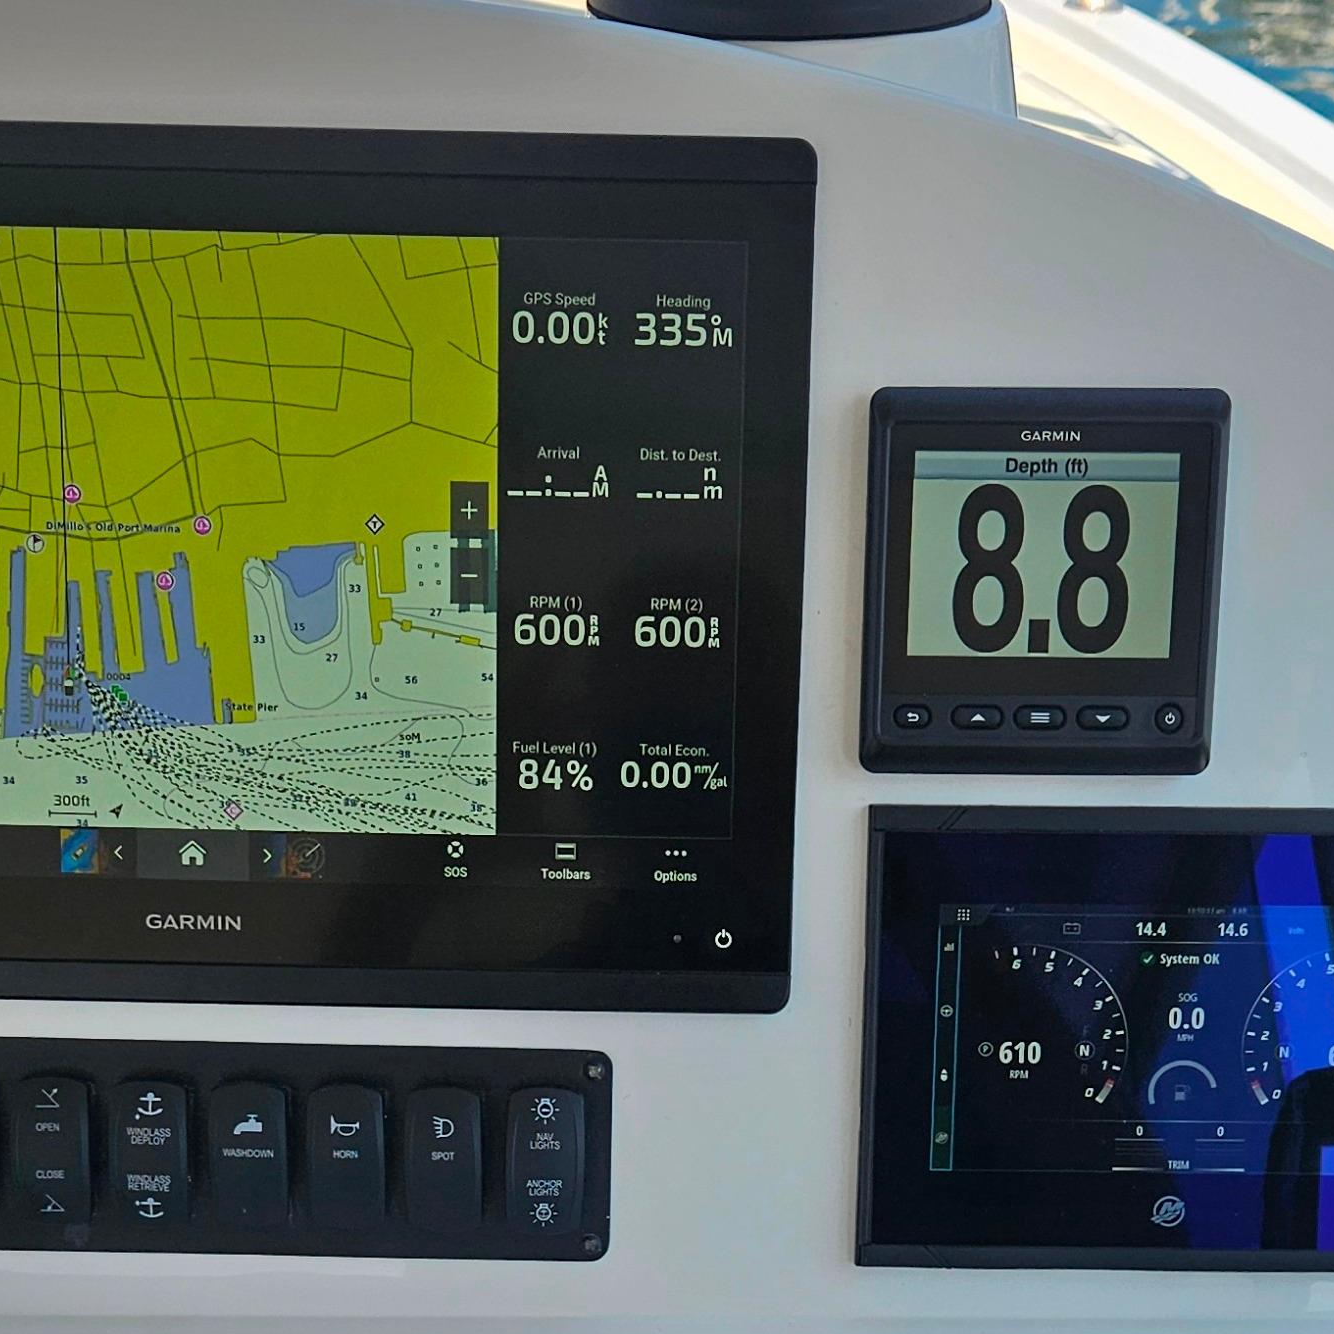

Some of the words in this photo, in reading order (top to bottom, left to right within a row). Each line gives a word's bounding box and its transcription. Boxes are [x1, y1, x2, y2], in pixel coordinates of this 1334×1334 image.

[524, 292, 552, 305] GPS
[555, 293, 596, 309] Speed
[656, 295, 711, 311] Heading
[512, 311, 596, 345] 0.00
[634, 312, 707, 346] 335
[1021, 430, 1081, 442] GARMIN
[537, 446, 580, 460] Arrival
[640, 448, 669, 461] Dist.
[672, 449, 686, 461] to
[689, 449, 722, 463] Dest.
[1005, 458, 1058, 478] Depth
[1065, 458, 1089, 477] (ft)
[95, 521, 115, 532] Old
[118, 521, 141, 532] Port
[143, 523, 181, 534] Marina
[952, 483, 1130, 654] 8.8
[348, 583, 362, 594] 33
[530, 596, 560, 609] RPM
[564, 596, 583, 611] (1)
[650, 598, 681, 612] RPM
[685, 598, 704, 613] (2)
[429, 607, 443, 618] 27
[293, 622, 306, 632] 15
[514, 613, 585, 646] 600
[634, 616, 706, 648] 600
[405, 675, 418, 685] 56
[355, 691, 368, 701] 34
[225, 702, 253, 712] State
[257, 702, 279, 712] Pier
[512, 742, 539, 755] Fuel
[542, 743, 576, 756] Level
[579, 741, 597, 758] (1)
[639, 743, 672, 757] Total
[675, 744, 710, 757] Econ.
[518, 759, 593, 791] 84%
[620, 760, 691, 789] 0.00
[54, 794, 90, 808] 300ft
[444, 867, 468, 878] SOS
[540, 868, 591, 881] Toolbars
[653, 869, 698, 885] Options
[146, 913, 243, 932] GARMIN
[1135, 922, 1167, 937] 14.4
[1217, 922, 1249, 938] 14.6
[1160, 953, 1200, 967] System
[1203, 953, 1220, 965] OK
[1178, 993, 1198, 1002] SOG
[1168, 1007, 1205, 1030] 0.0
[1177, 1034, 1194, 1042] MPH
[999, 1041, 1042, 1064] 610
[1079, 1045, 1090, 1056] N
[1279, 1047, 1290, 1058] N
[1009, 1070, 1029, 1079] RPM
[35, 1122, 60, 1132] OPEN
[126, 1127, 171, 1138] WINDLASS
[130, 1136, 167, 1146] DEPLOY
[536, 1133, 554, 1142] NAV
[530, 1141, 561, 1151] LIGHTS
[222, 1147, 274, 1158] WASHDOWN
[333, 1149, 358, 1159] HORN
[431, 1151, 454, 1161] SPOT
[1168, 1160, 1190, 1170] TRIM
[35, 1169, 65, 1180] CLOSE
[127, 1174, 171, 1185] WINDLASS
[127, 1183, 170, 1193] RETRIEVE
[526, 1179, 563, 1190] ANCHOR
[529, 1187, 560, 1197] LIGHTS
